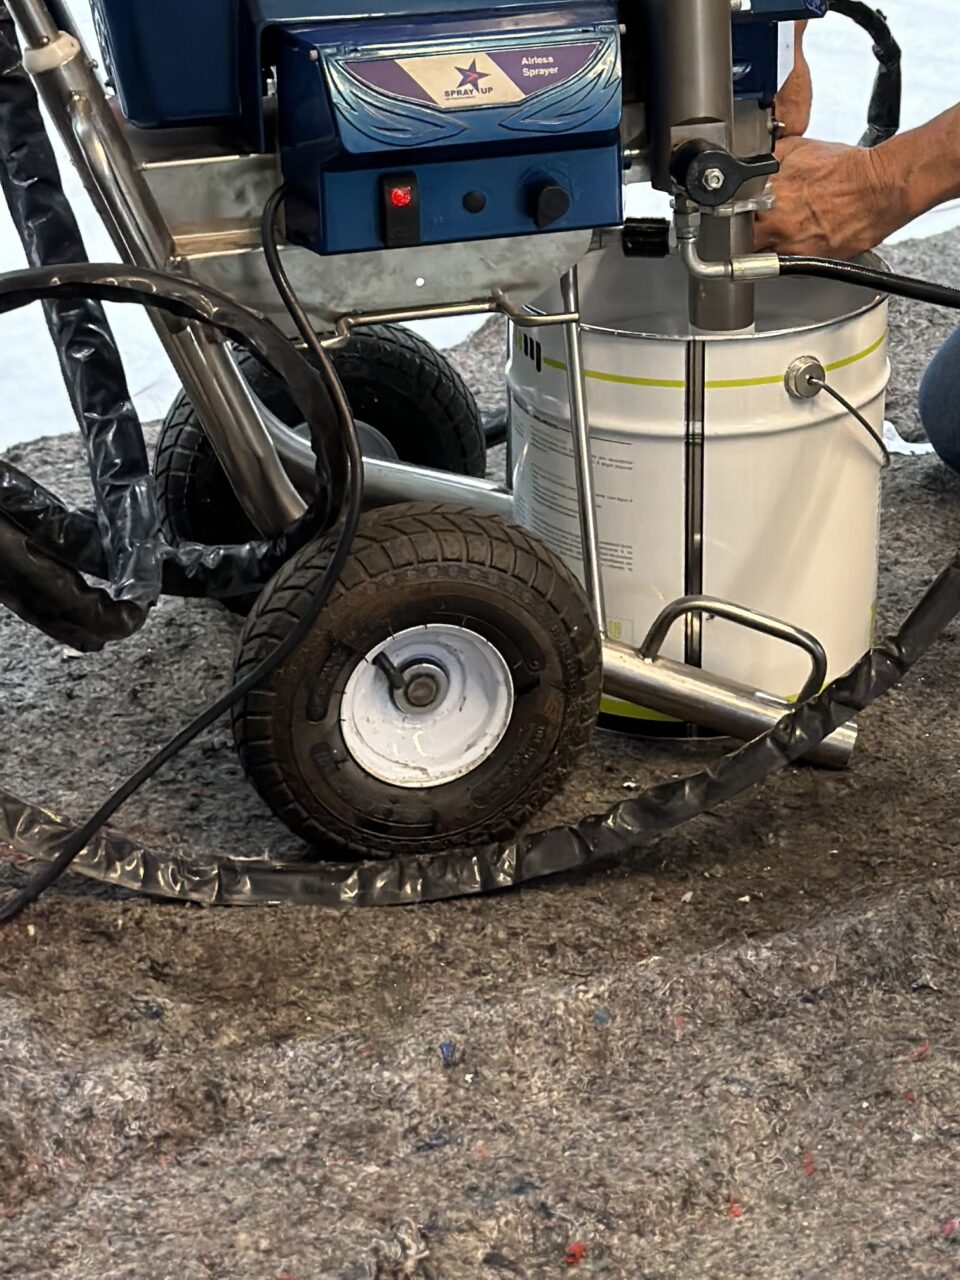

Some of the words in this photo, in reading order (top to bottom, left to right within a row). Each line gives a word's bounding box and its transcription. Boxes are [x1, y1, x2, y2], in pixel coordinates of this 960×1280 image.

[521, 56, 554, 66] Airless
[522, 67, 559, 78] Sprayer
[444, 88, 474, 97] SPRAY
[480, 86, 493, 94] UP
